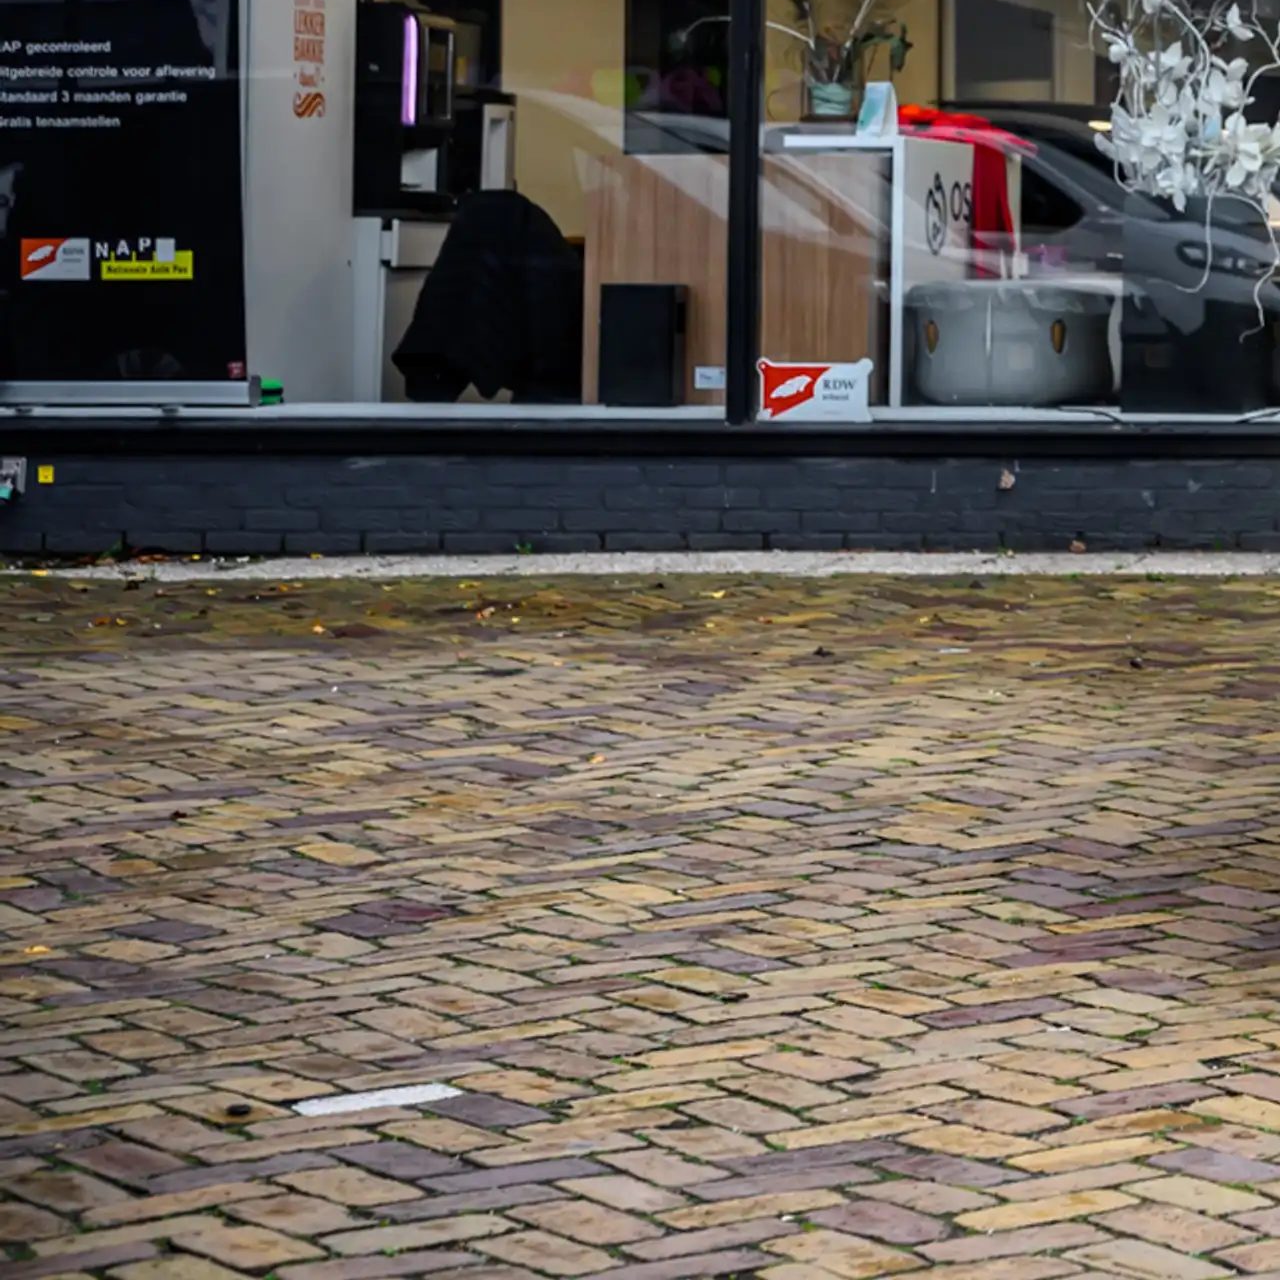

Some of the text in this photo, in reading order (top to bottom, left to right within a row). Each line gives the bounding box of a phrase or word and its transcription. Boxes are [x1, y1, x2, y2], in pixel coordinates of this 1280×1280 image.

[0, 40, 112, 56] AP gecontroleerd
[67, 65, 118, 78] controle
[122, 68, 151, 78] voor
[156, 64, 216, 79] aflevering
[0, 90, 187, 105] tandaard 3 maanden garantie
[823, 379, 856, 390] RDW
